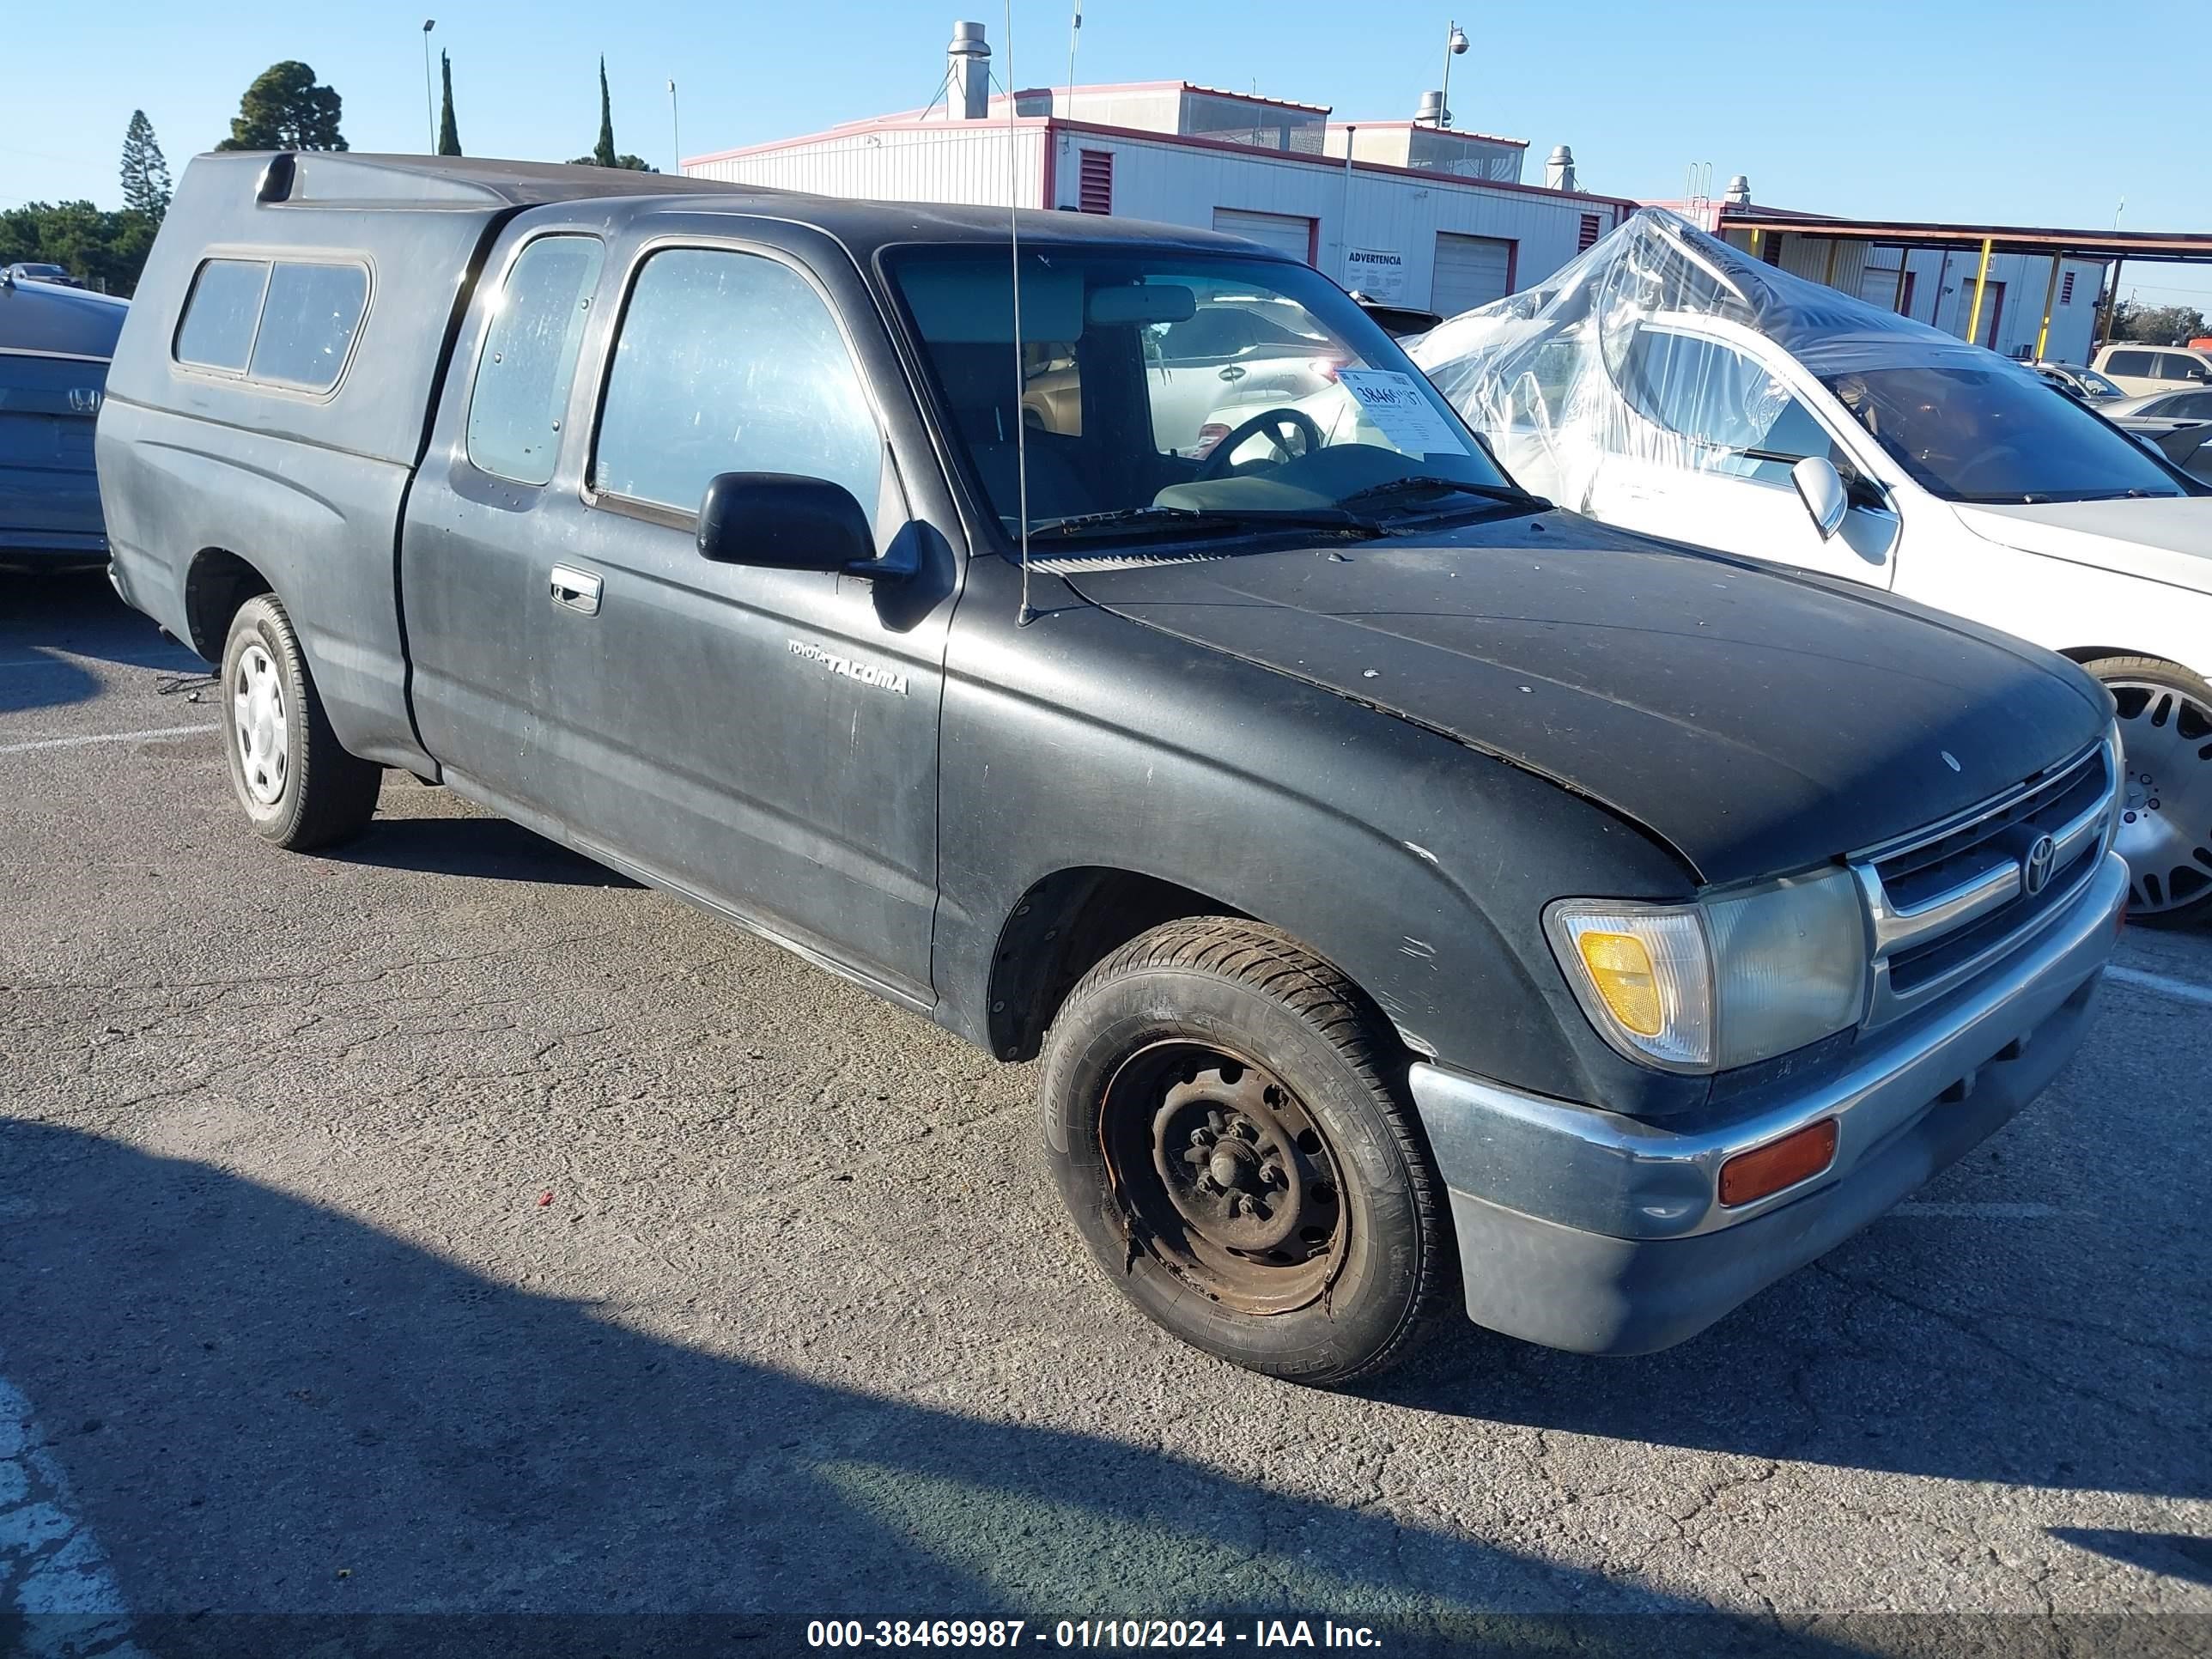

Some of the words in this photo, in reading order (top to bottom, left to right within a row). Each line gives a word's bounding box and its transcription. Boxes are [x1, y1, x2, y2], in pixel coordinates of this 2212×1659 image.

[1348, 252, 1401, 265] ADVERTENCIA
[787, 638, 827, 663] TOYOTA
[825, 654, 909, 695] TACOMA
[1048, 1065, 1064, 1127] 215/70
